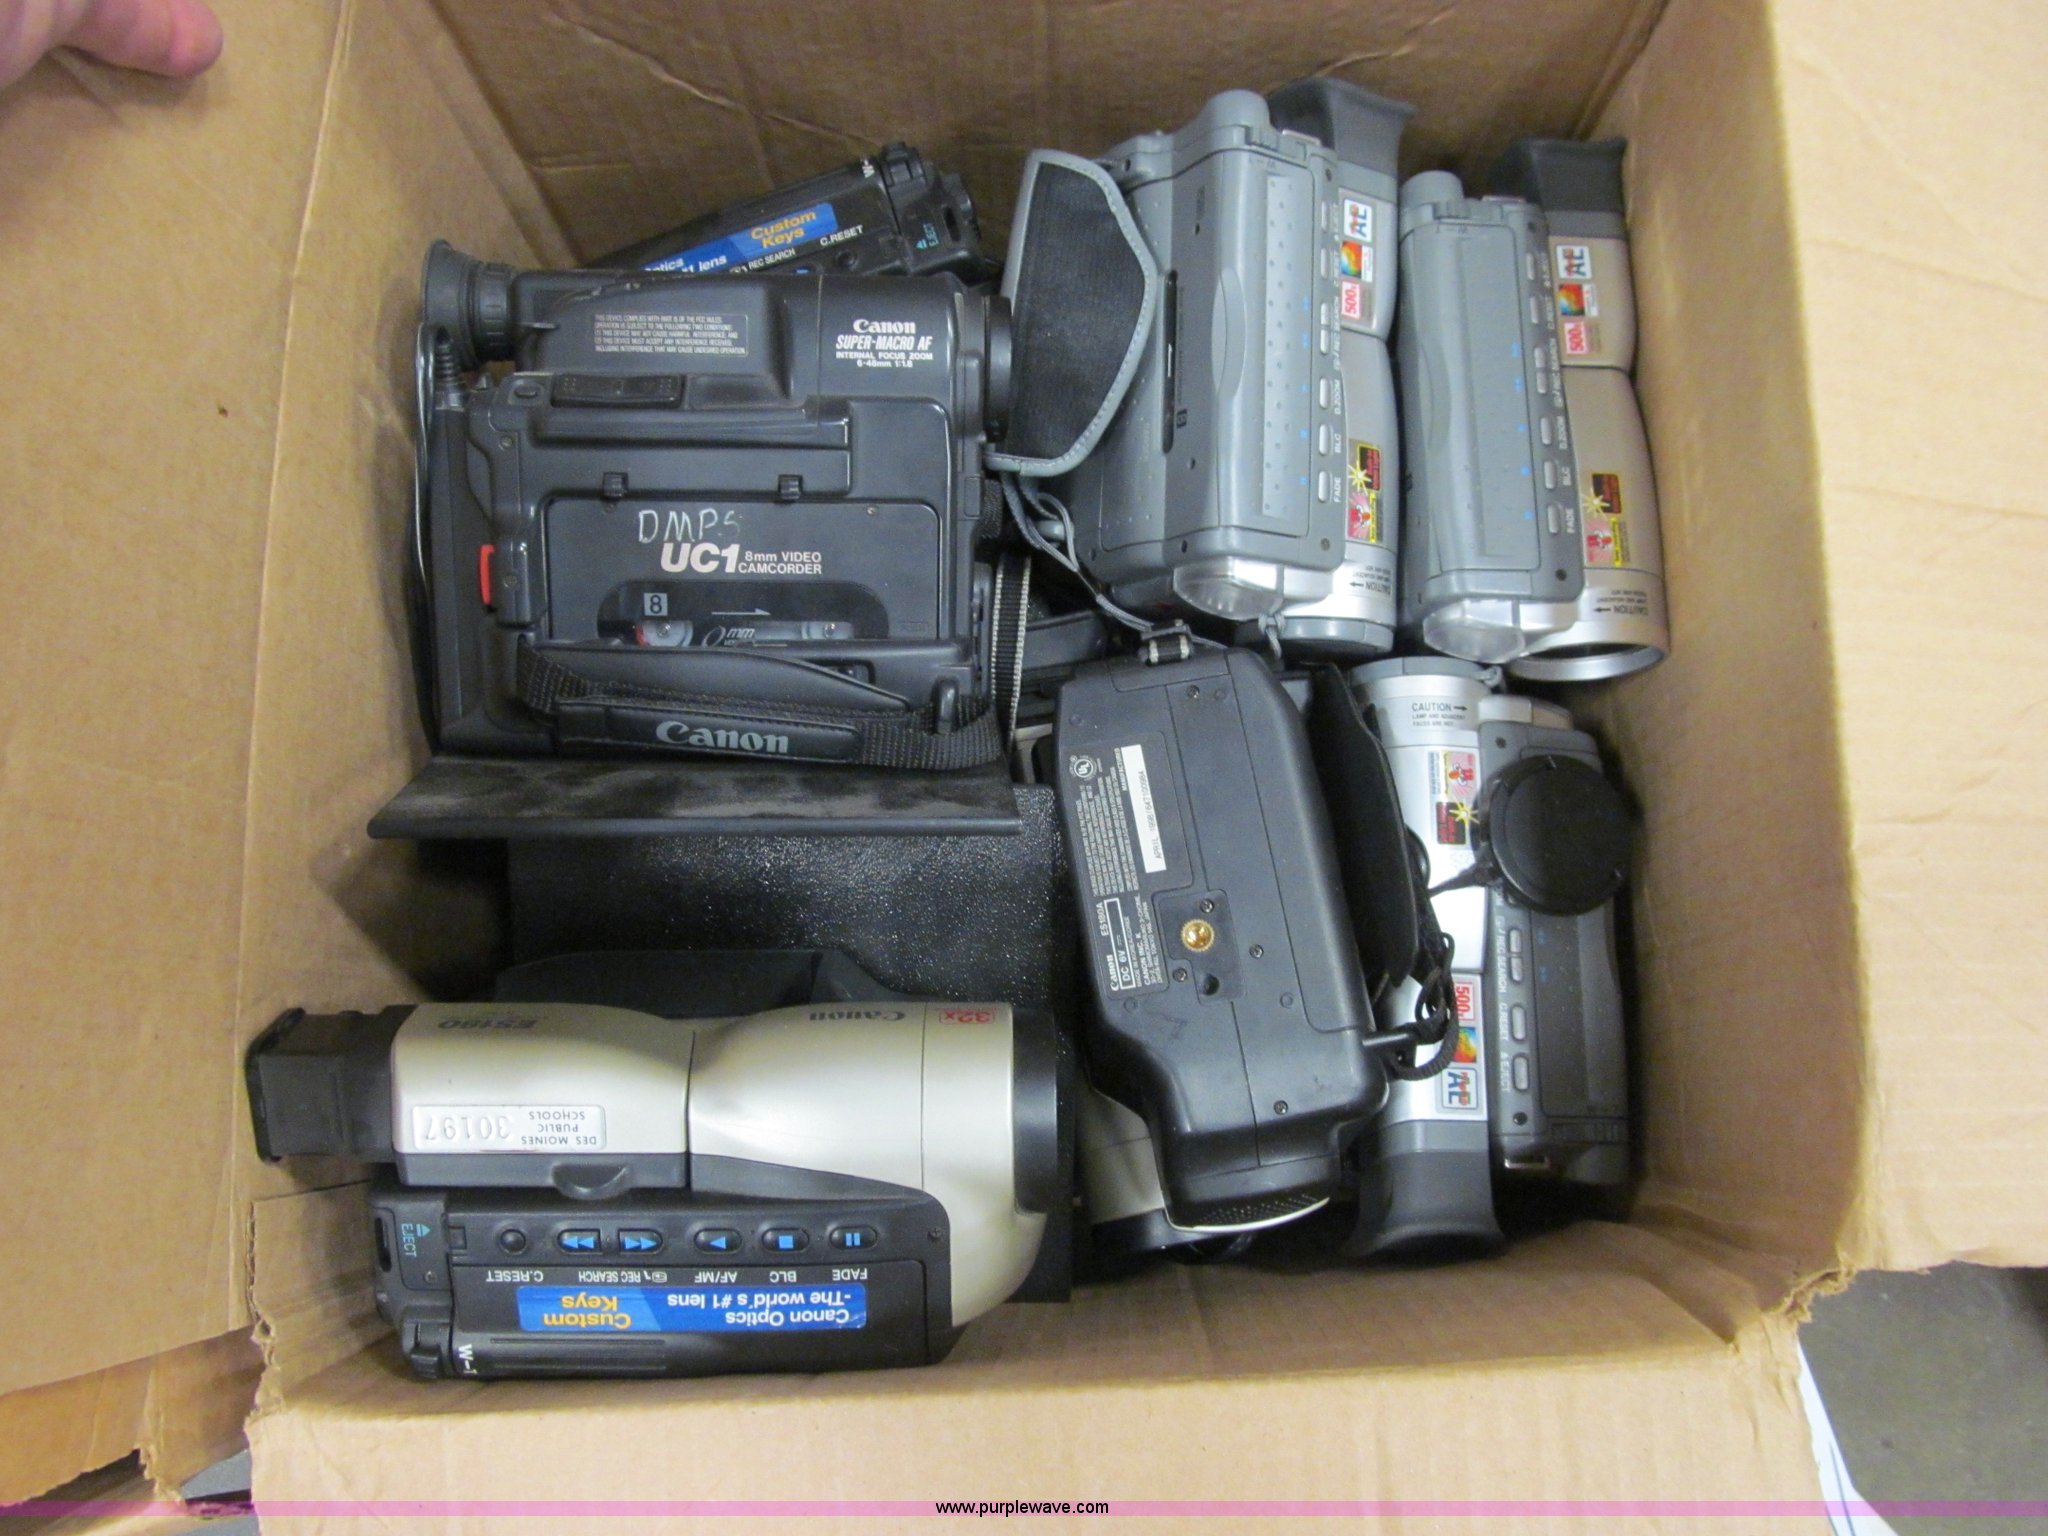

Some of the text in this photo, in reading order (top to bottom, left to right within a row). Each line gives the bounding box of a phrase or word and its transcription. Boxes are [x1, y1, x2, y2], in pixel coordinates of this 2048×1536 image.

[751, 210, 816, 239] Custom
[763, 227, 804, 249] Keys
[820, 224, 864, 246] C.RESET
[699, 253, 727, 271] lens
[748, 247, 796, 270] REC SEARCH
[853, 319, 916, 334] Canon
[836, 335, 933, 350] SUPER-MACRO AF
[836, 351, 933, 360] INTERNAL FOCUS ZOOM
[1562, 467, 1571, 486] BLC
[1565, 508, 1575, 533] FADE
[661, 542, 740, 573] UC1
[745, 551, 822, 563] 8mm VIDEO
[738, 563, 822, 575] CAMCORDER
[650, 594, 663, 614] 8
[1411, 702, 1452, 712] CAUTION
[655, 721, 789, 754] Canon
[1096, 902, 1109, 936] ES180A
[1106, 954, 1119, 991] Canon
[1117, 950, 1131, 981] DC 6V
[1140, 956, 1150, 985] CANON
[809, 1010, 905, 1022] Canon
[528, 1110, 585, 1120] SCHOOLS
[424, 1115, 511, 1140] 30197
[537, 1123, 578, 1133] PUBLIC
[520, 1136, 597, 1145] DES MOINES
[402, 1223, 417, 1257] EJECT
[486, 1270, 544, 1282] C.RESET
[578, 1271, 641, 1282] REC SEARCH
[694, 1271, 738, 1283] AF/MF
[769, 1270, 797, 1282] BLC
[832, 1268, 868, 1281] FADE
[561, 1292, 617, 1310] Keys
[667, 1294, 706, 1309] lens
[712, 1294, 732, 1309] #1
[544, 1313, 632, 1328] Custom
[725, 1308, 849, 1326] Canon Optics
